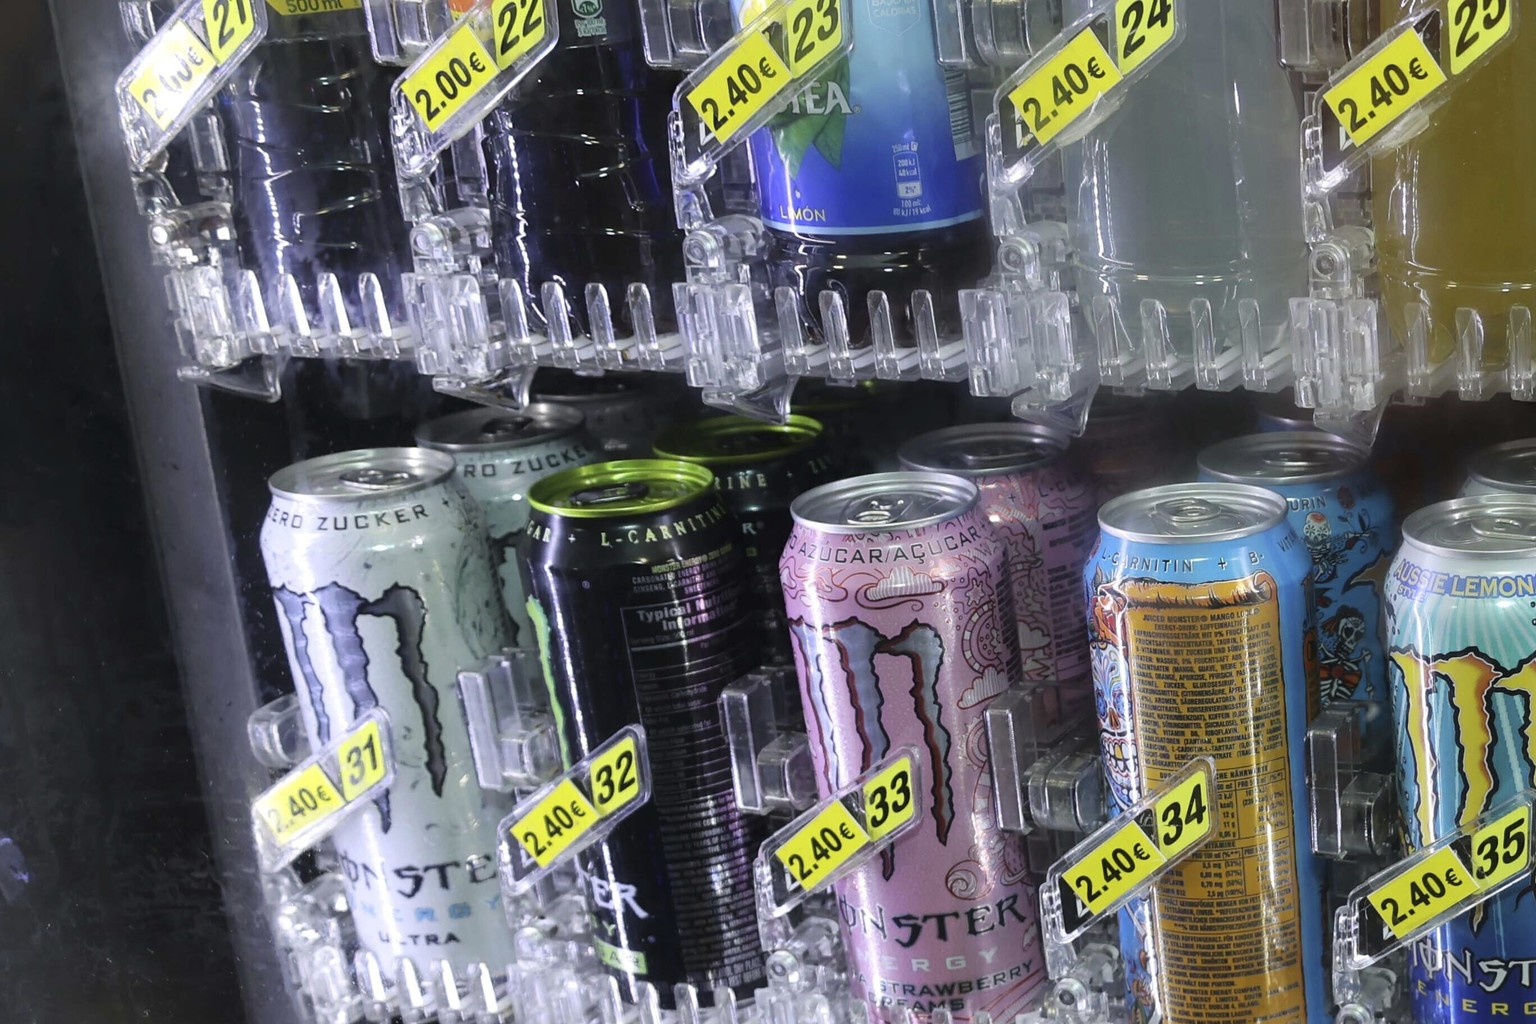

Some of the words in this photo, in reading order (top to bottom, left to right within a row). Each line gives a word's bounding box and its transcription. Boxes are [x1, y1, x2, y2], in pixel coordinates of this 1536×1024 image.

[499, 0, 542, 57] 22
[792, 0, 839, 63] 23
[1121, 0, 1172, 59] 24
[1455, 0, 1512, 58] 25
[415, 51, 487, 122] 2.00€
[700, 56, 777, 132] 2.40€
[1022, 56, 1106, 133] 2.40€
[1337, 56, 1429, 133] 2.40€
[780, 205, 826, 222] LIMÓN
[316, 503, 430, 532] ZUCKER
[1392, 558, 1448, 595] AUSSIE
[637, 601, 692, 624] Typical
[345, 733, 378, 786] 31
[594, 749, 636, 806] 32
[868, 770, 911, 828] 33
[1161, 783, 1207, 846] 34
[523, 800, 586, 857] 2.40€
[788, 821, 856, 880] 2.40€
[1475, 817, 1526, 880] 35
[1075, 842, 1151, 903] 2.40€
[1381, 867, 1463, 926] 2.40€
[879, 958, 1034, 998] STRAWBERRY
